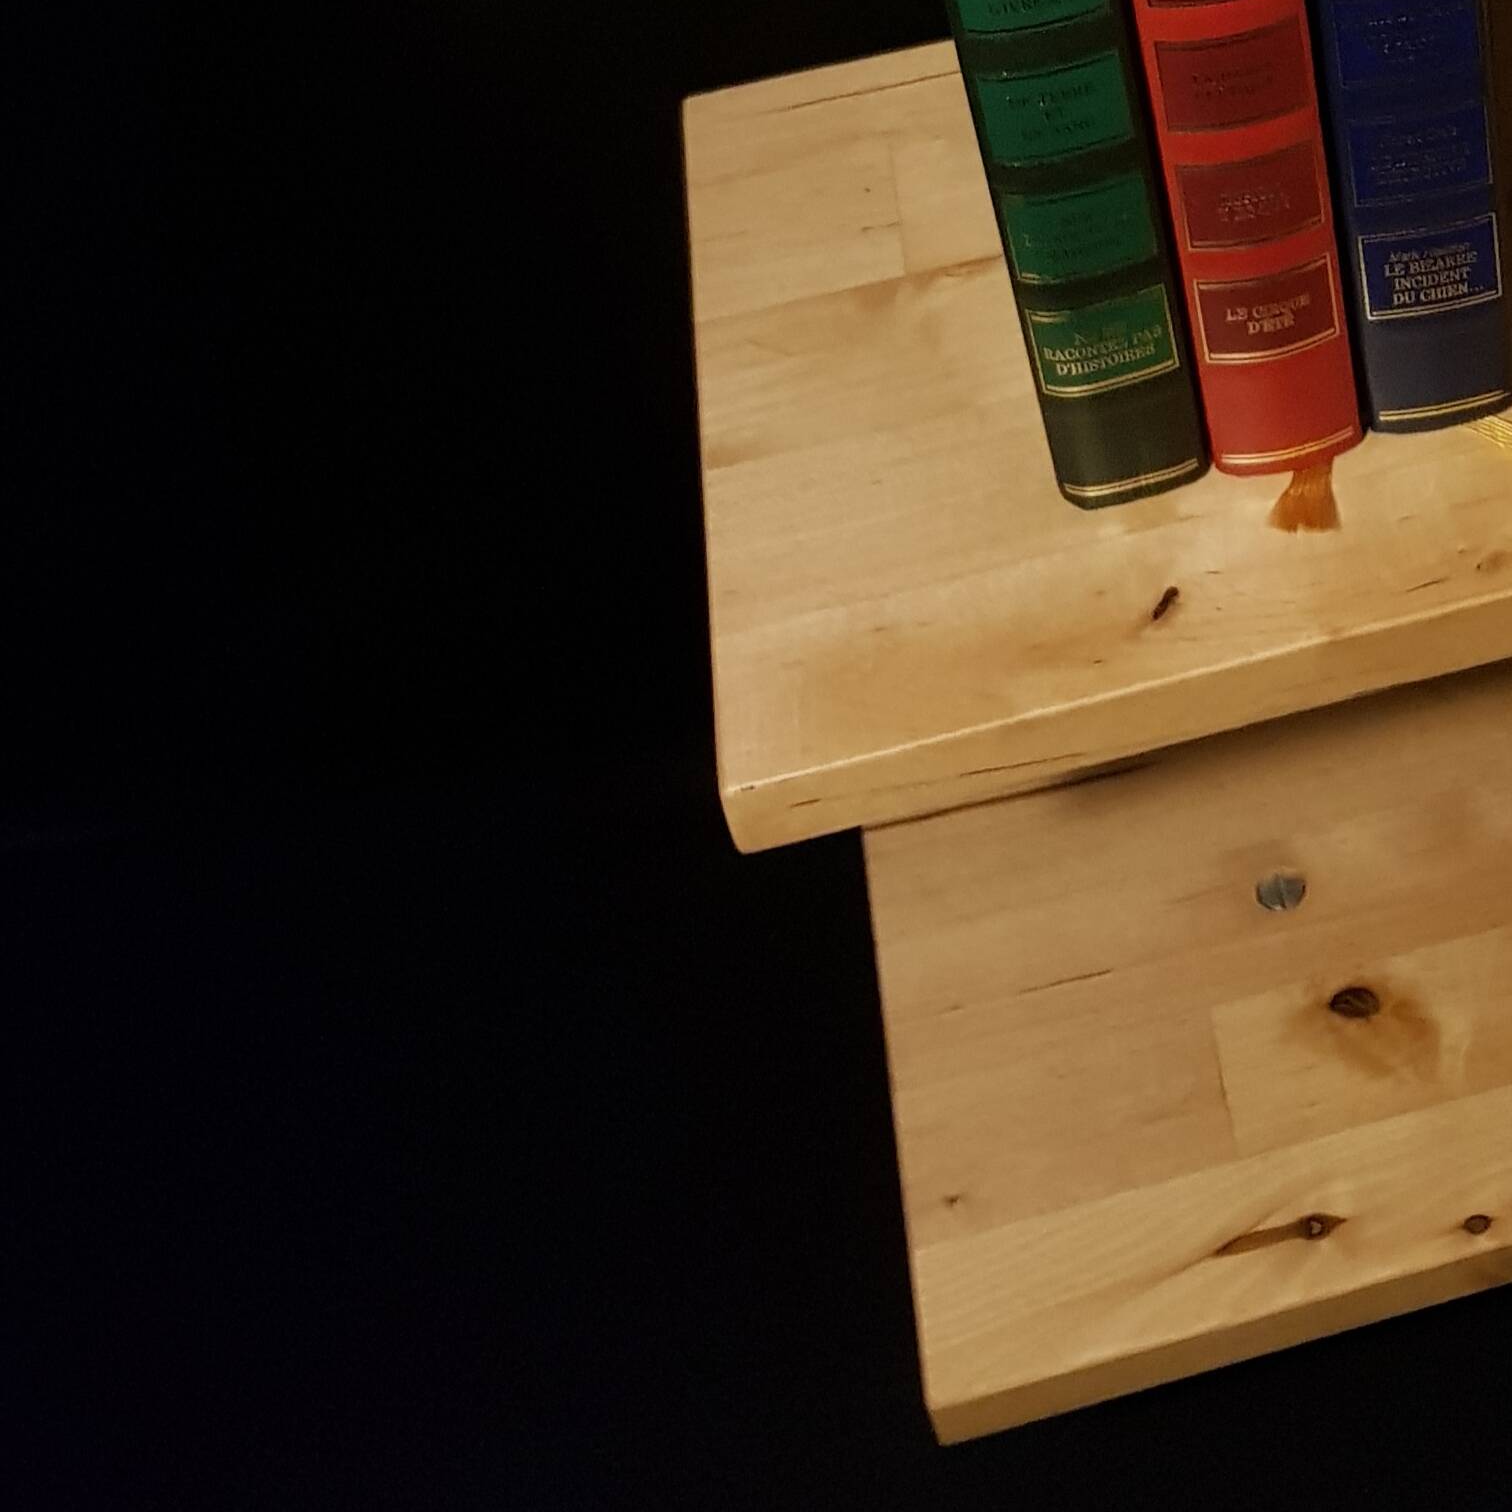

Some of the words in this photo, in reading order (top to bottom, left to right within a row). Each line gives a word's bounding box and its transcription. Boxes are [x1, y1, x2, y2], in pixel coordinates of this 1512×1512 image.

[1384, 263, 1407, 279] LE
[1393, 265, 1472, 291] INCIDENT
[1392, 290, 1417, 306] DU
